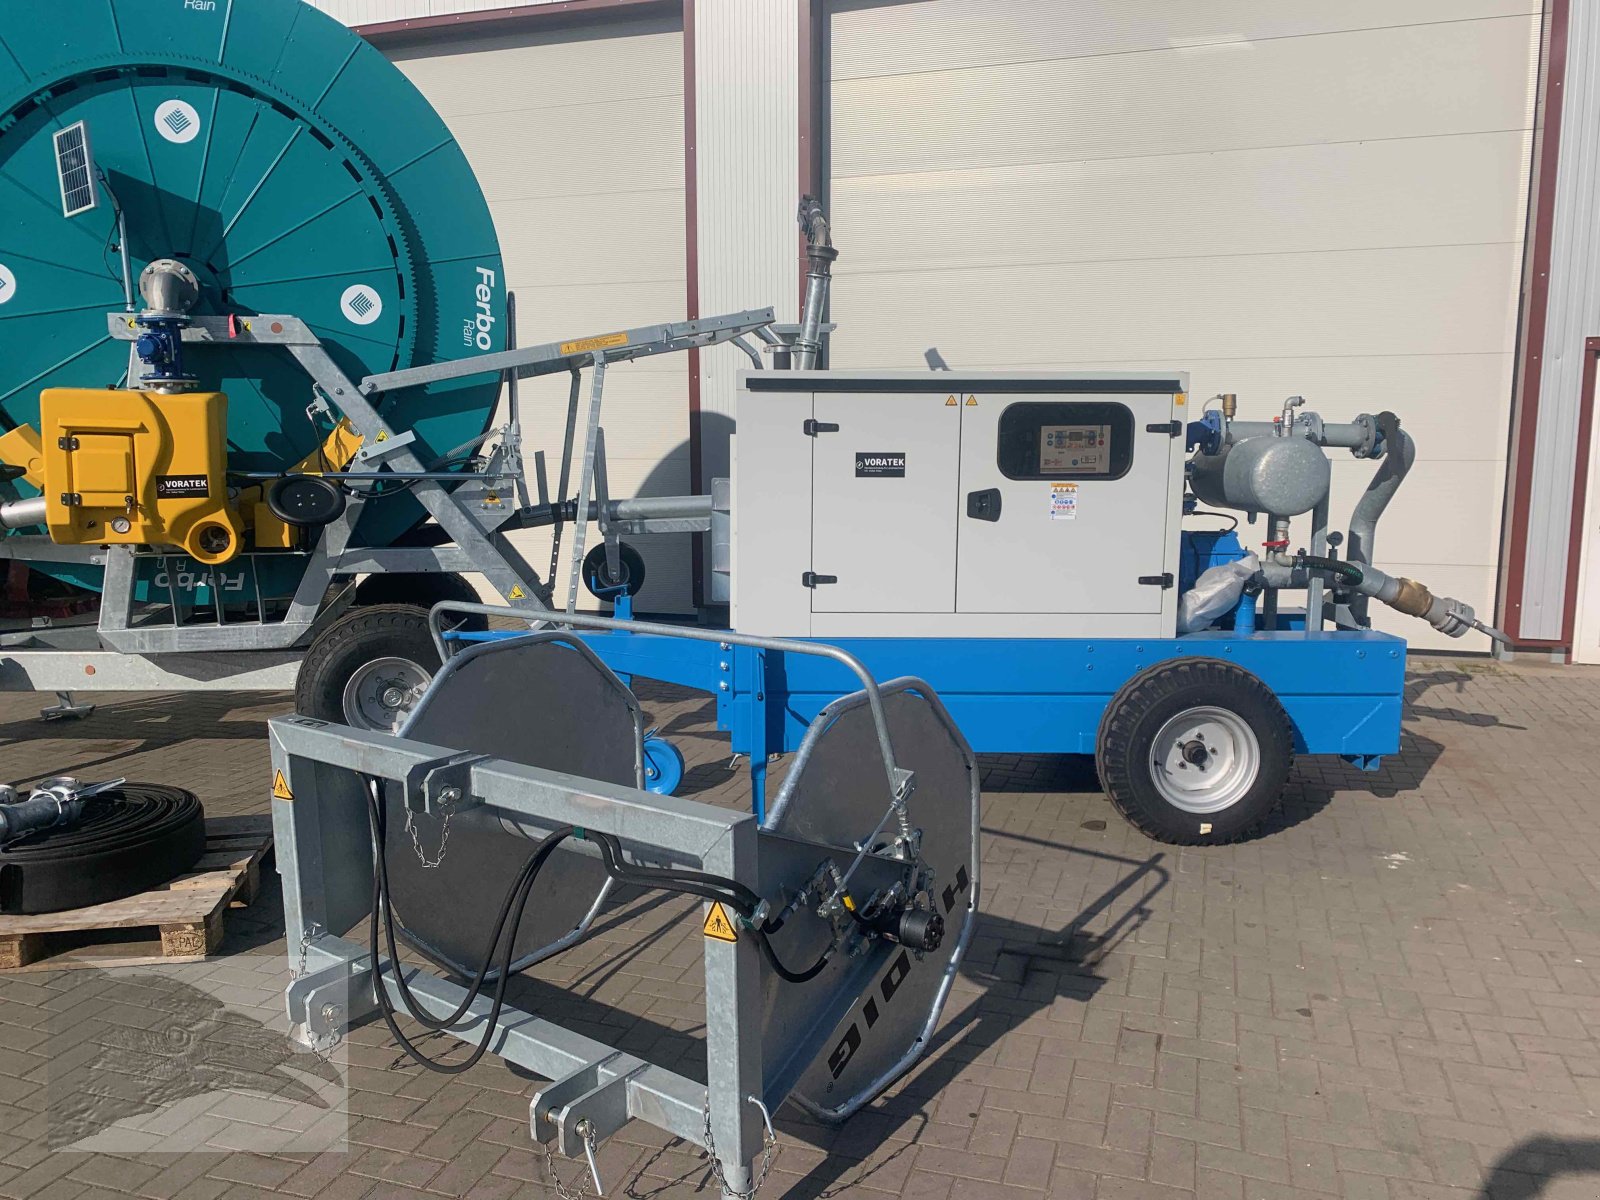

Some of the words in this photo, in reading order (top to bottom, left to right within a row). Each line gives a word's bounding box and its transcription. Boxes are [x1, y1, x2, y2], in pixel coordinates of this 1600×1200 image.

[184, 0, 216, 11] Rain
[475, 266, 496, 351] Ferbo
[463, 318, 476, 347] Rain
[864, 457, 905, 467] VORATEK
[165, 479, 207, 488] VORATEK
[827, 864, 969, 1081] HDIG
